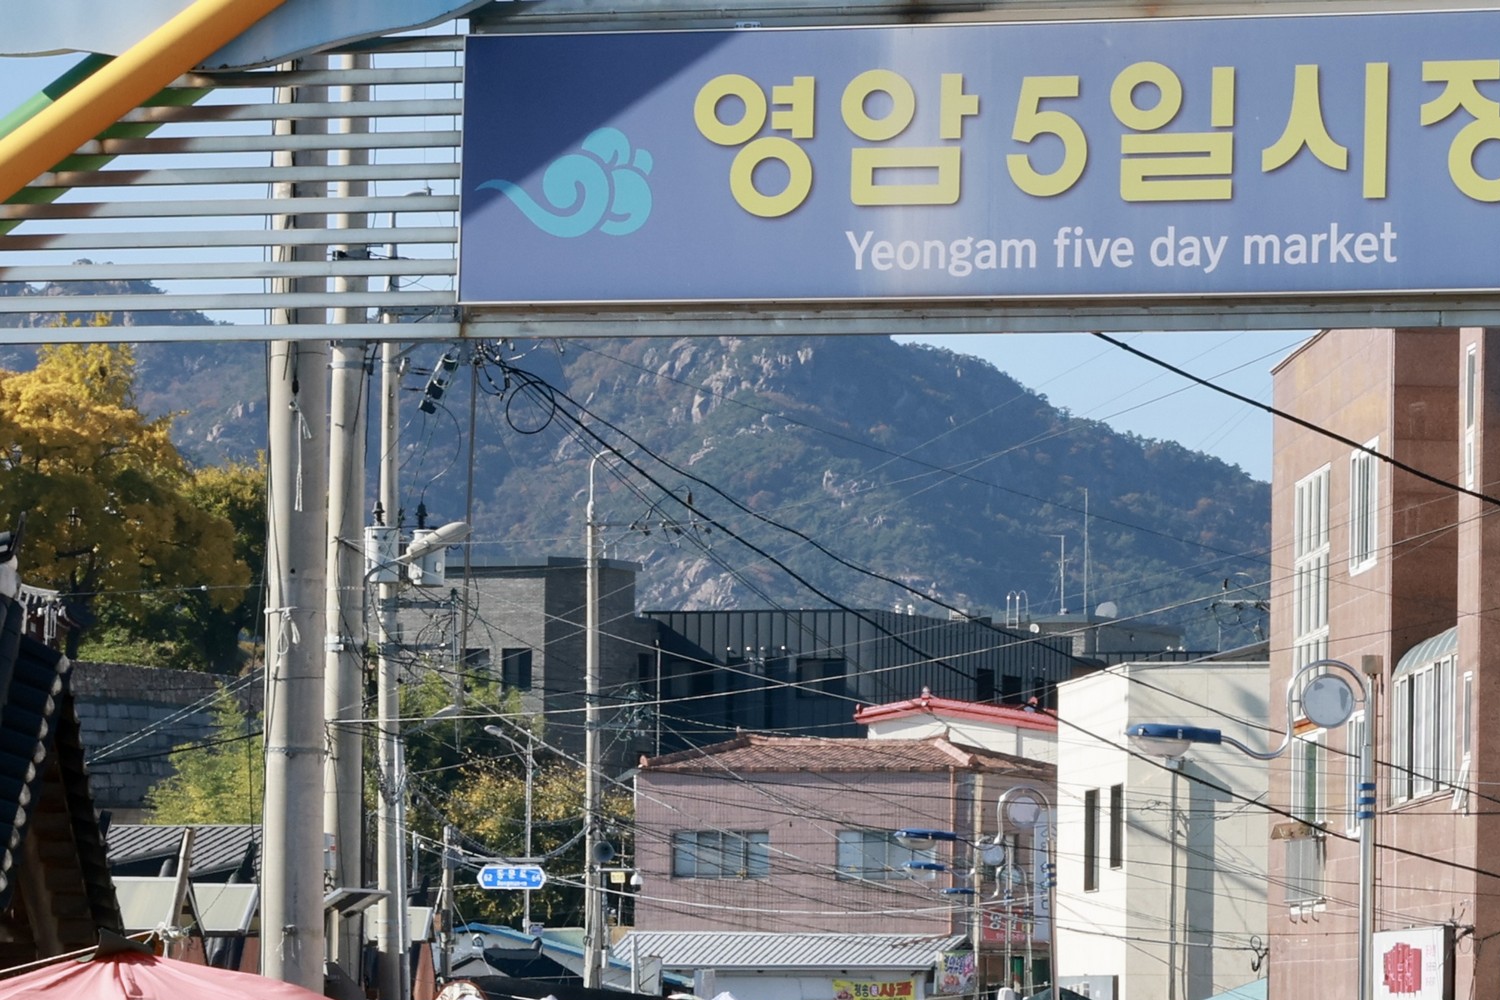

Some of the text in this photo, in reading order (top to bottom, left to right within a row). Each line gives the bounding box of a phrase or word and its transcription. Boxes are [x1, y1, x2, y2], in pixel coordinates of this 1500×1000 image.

[845, 222, 1398, 277] Yeongam five day market
